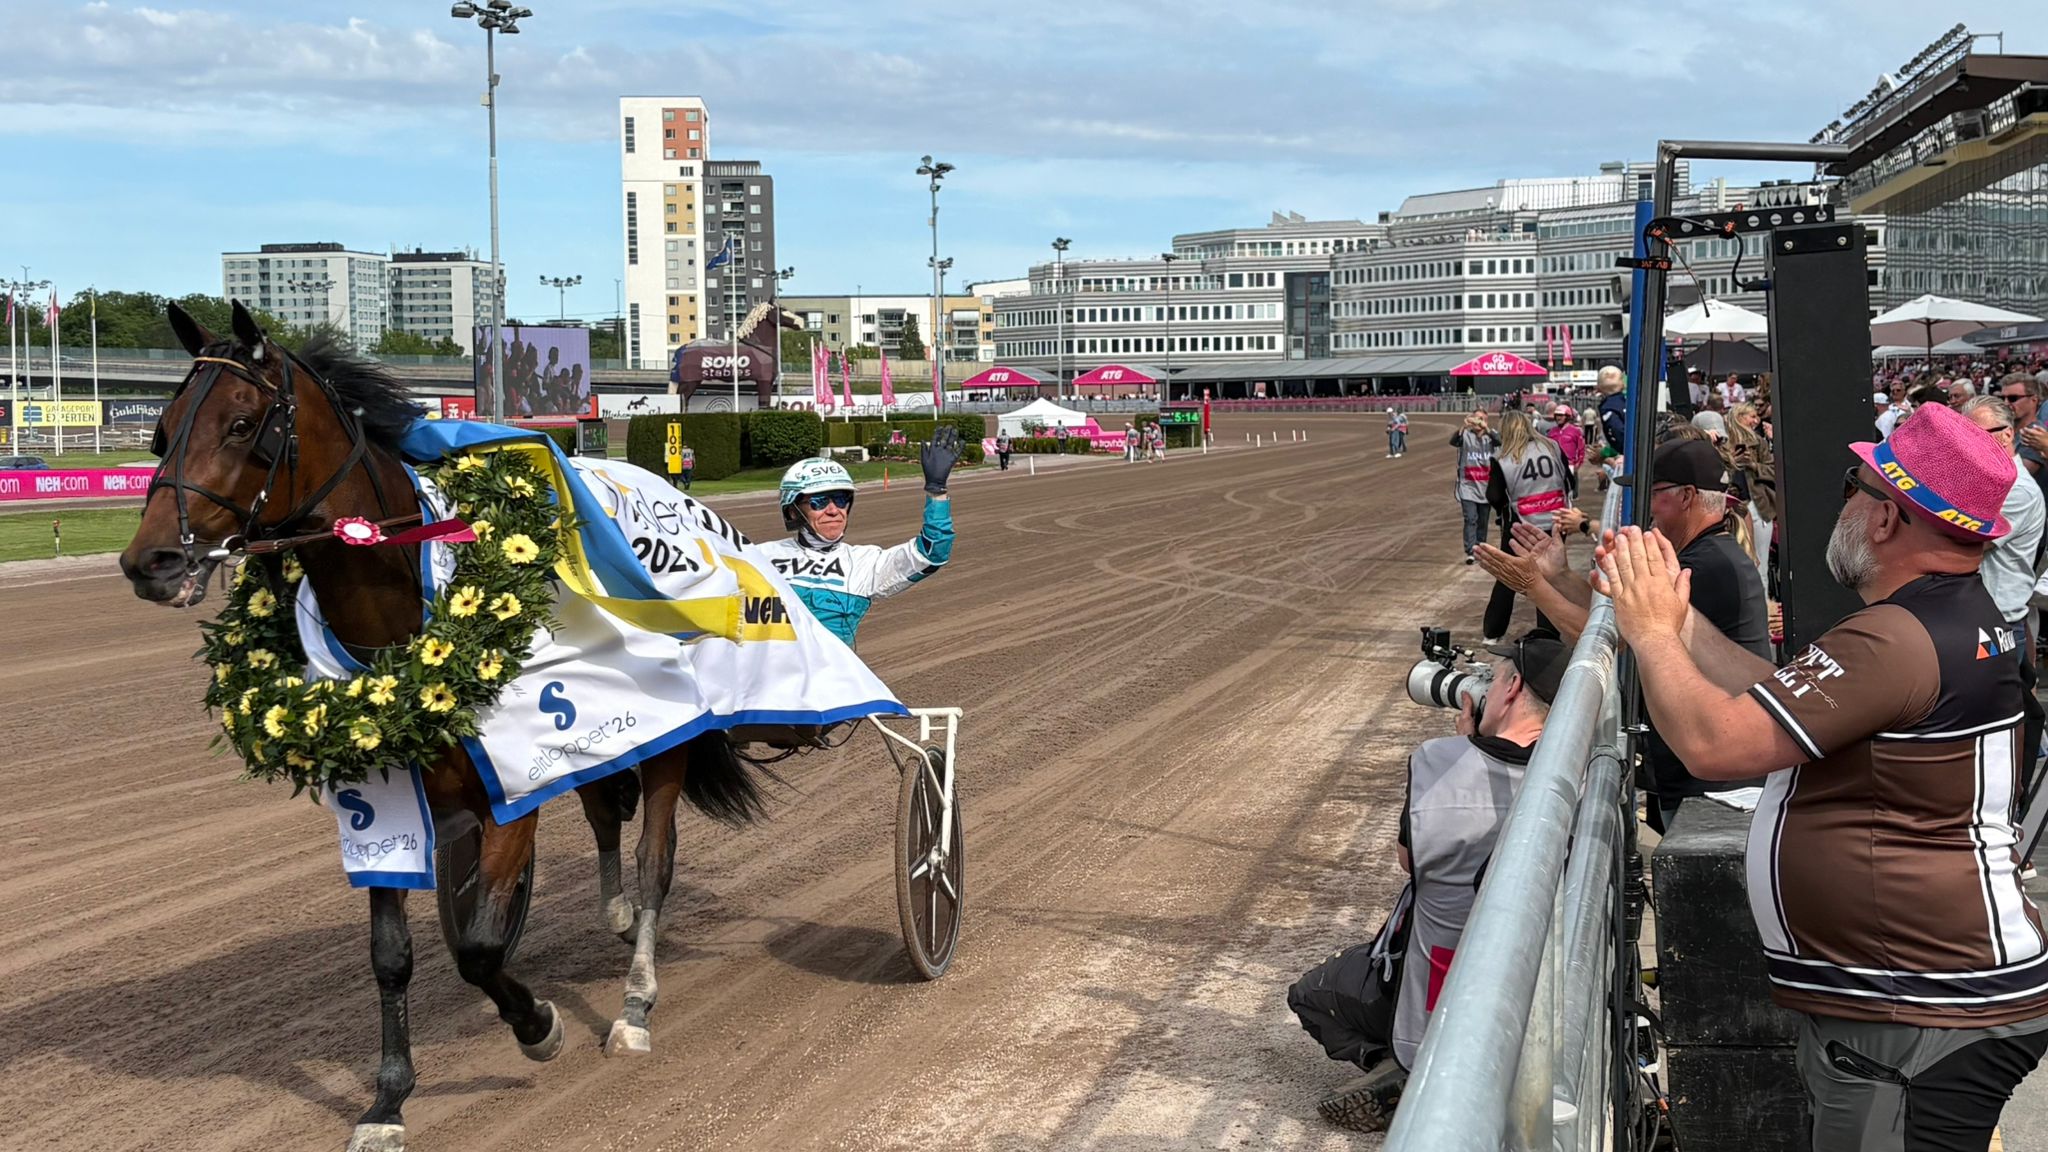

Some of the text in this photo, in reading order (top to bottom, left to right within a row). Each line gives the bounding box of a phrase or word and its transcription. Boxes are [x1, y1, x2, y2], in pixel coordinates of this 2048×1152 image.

[701, 356, 751, 369] BOKO
[988, 371, 1009, 382] ATG
[1100, 369, 1123, 381] ATG
[810, 465, 845, 476] SVEA
[1522, 455, 1554, 481] 40
[1881, 460, 1917, 491] ATG
[1936, 508, 1983, 531] ATG
